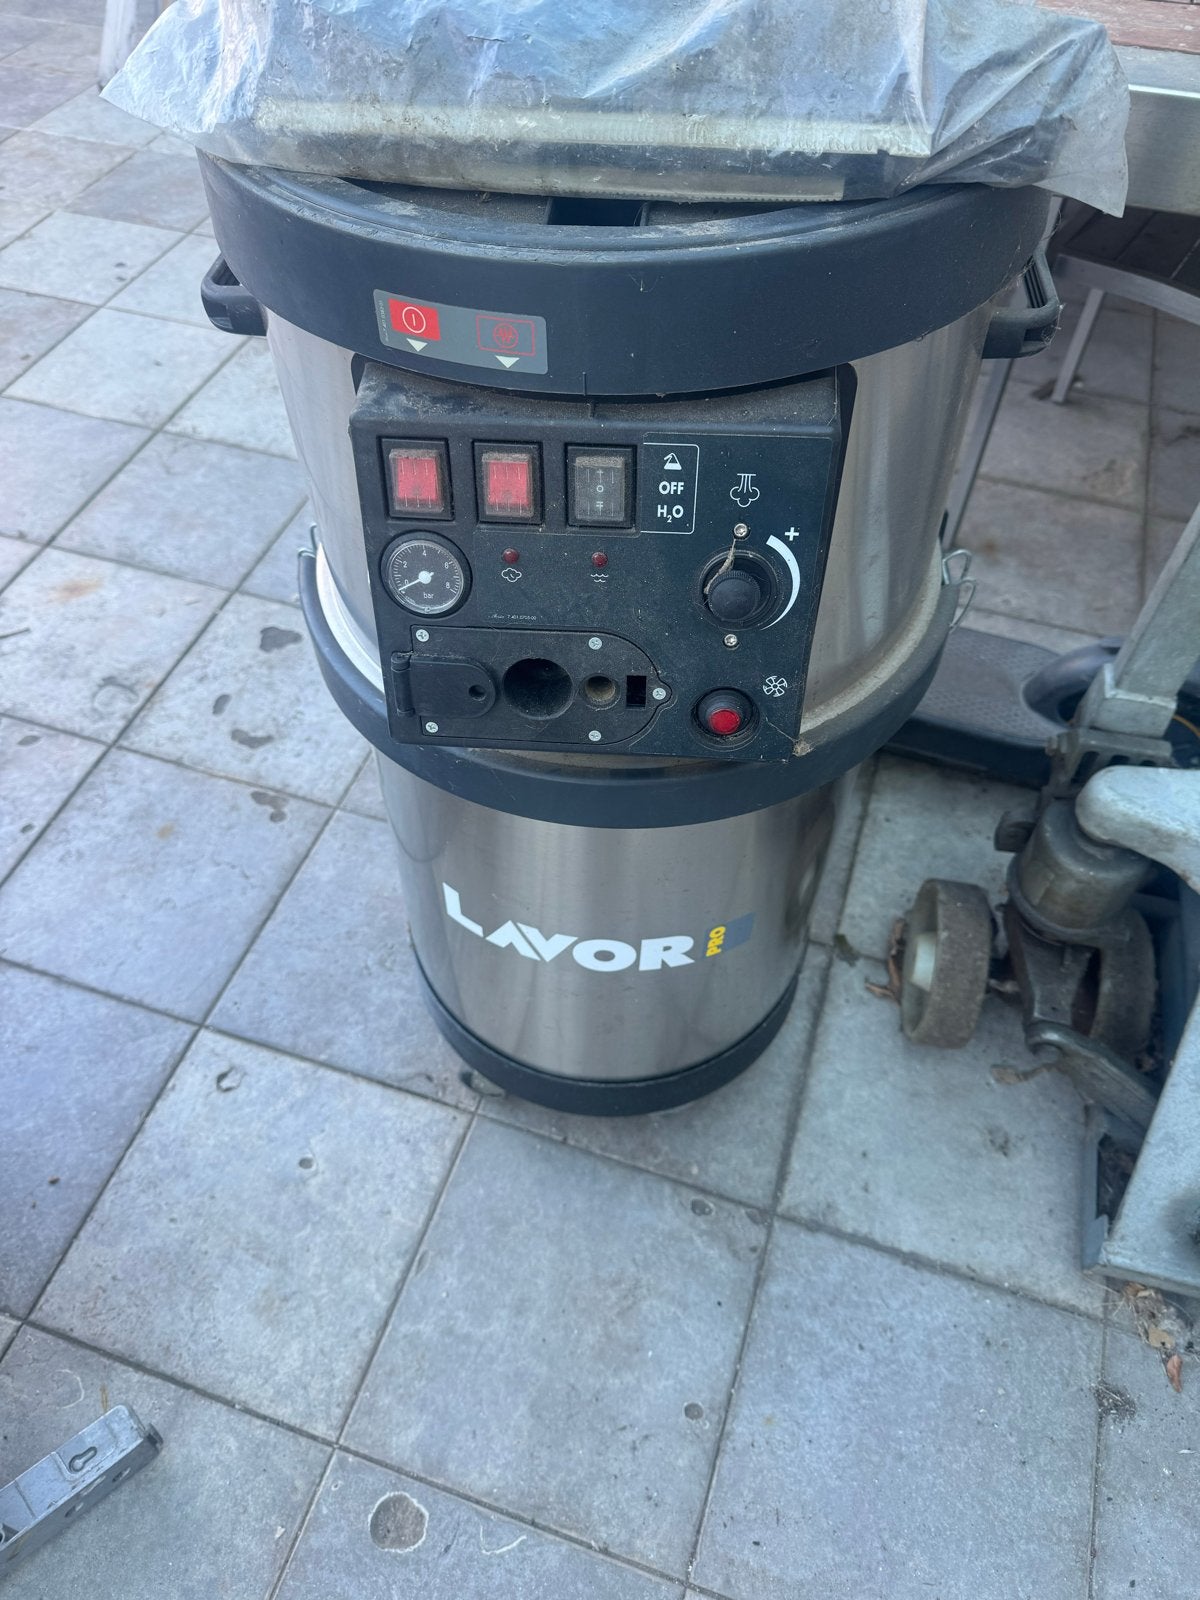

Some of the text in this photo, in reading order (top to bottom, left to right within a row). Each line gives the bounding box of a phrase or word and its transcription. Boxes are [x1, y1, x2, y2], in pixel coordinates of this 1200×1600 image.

[659, 481, 684, 494] OFF
[443, 882, 695, 972] LAVOR
[706, 926, 726, 957] PRO
